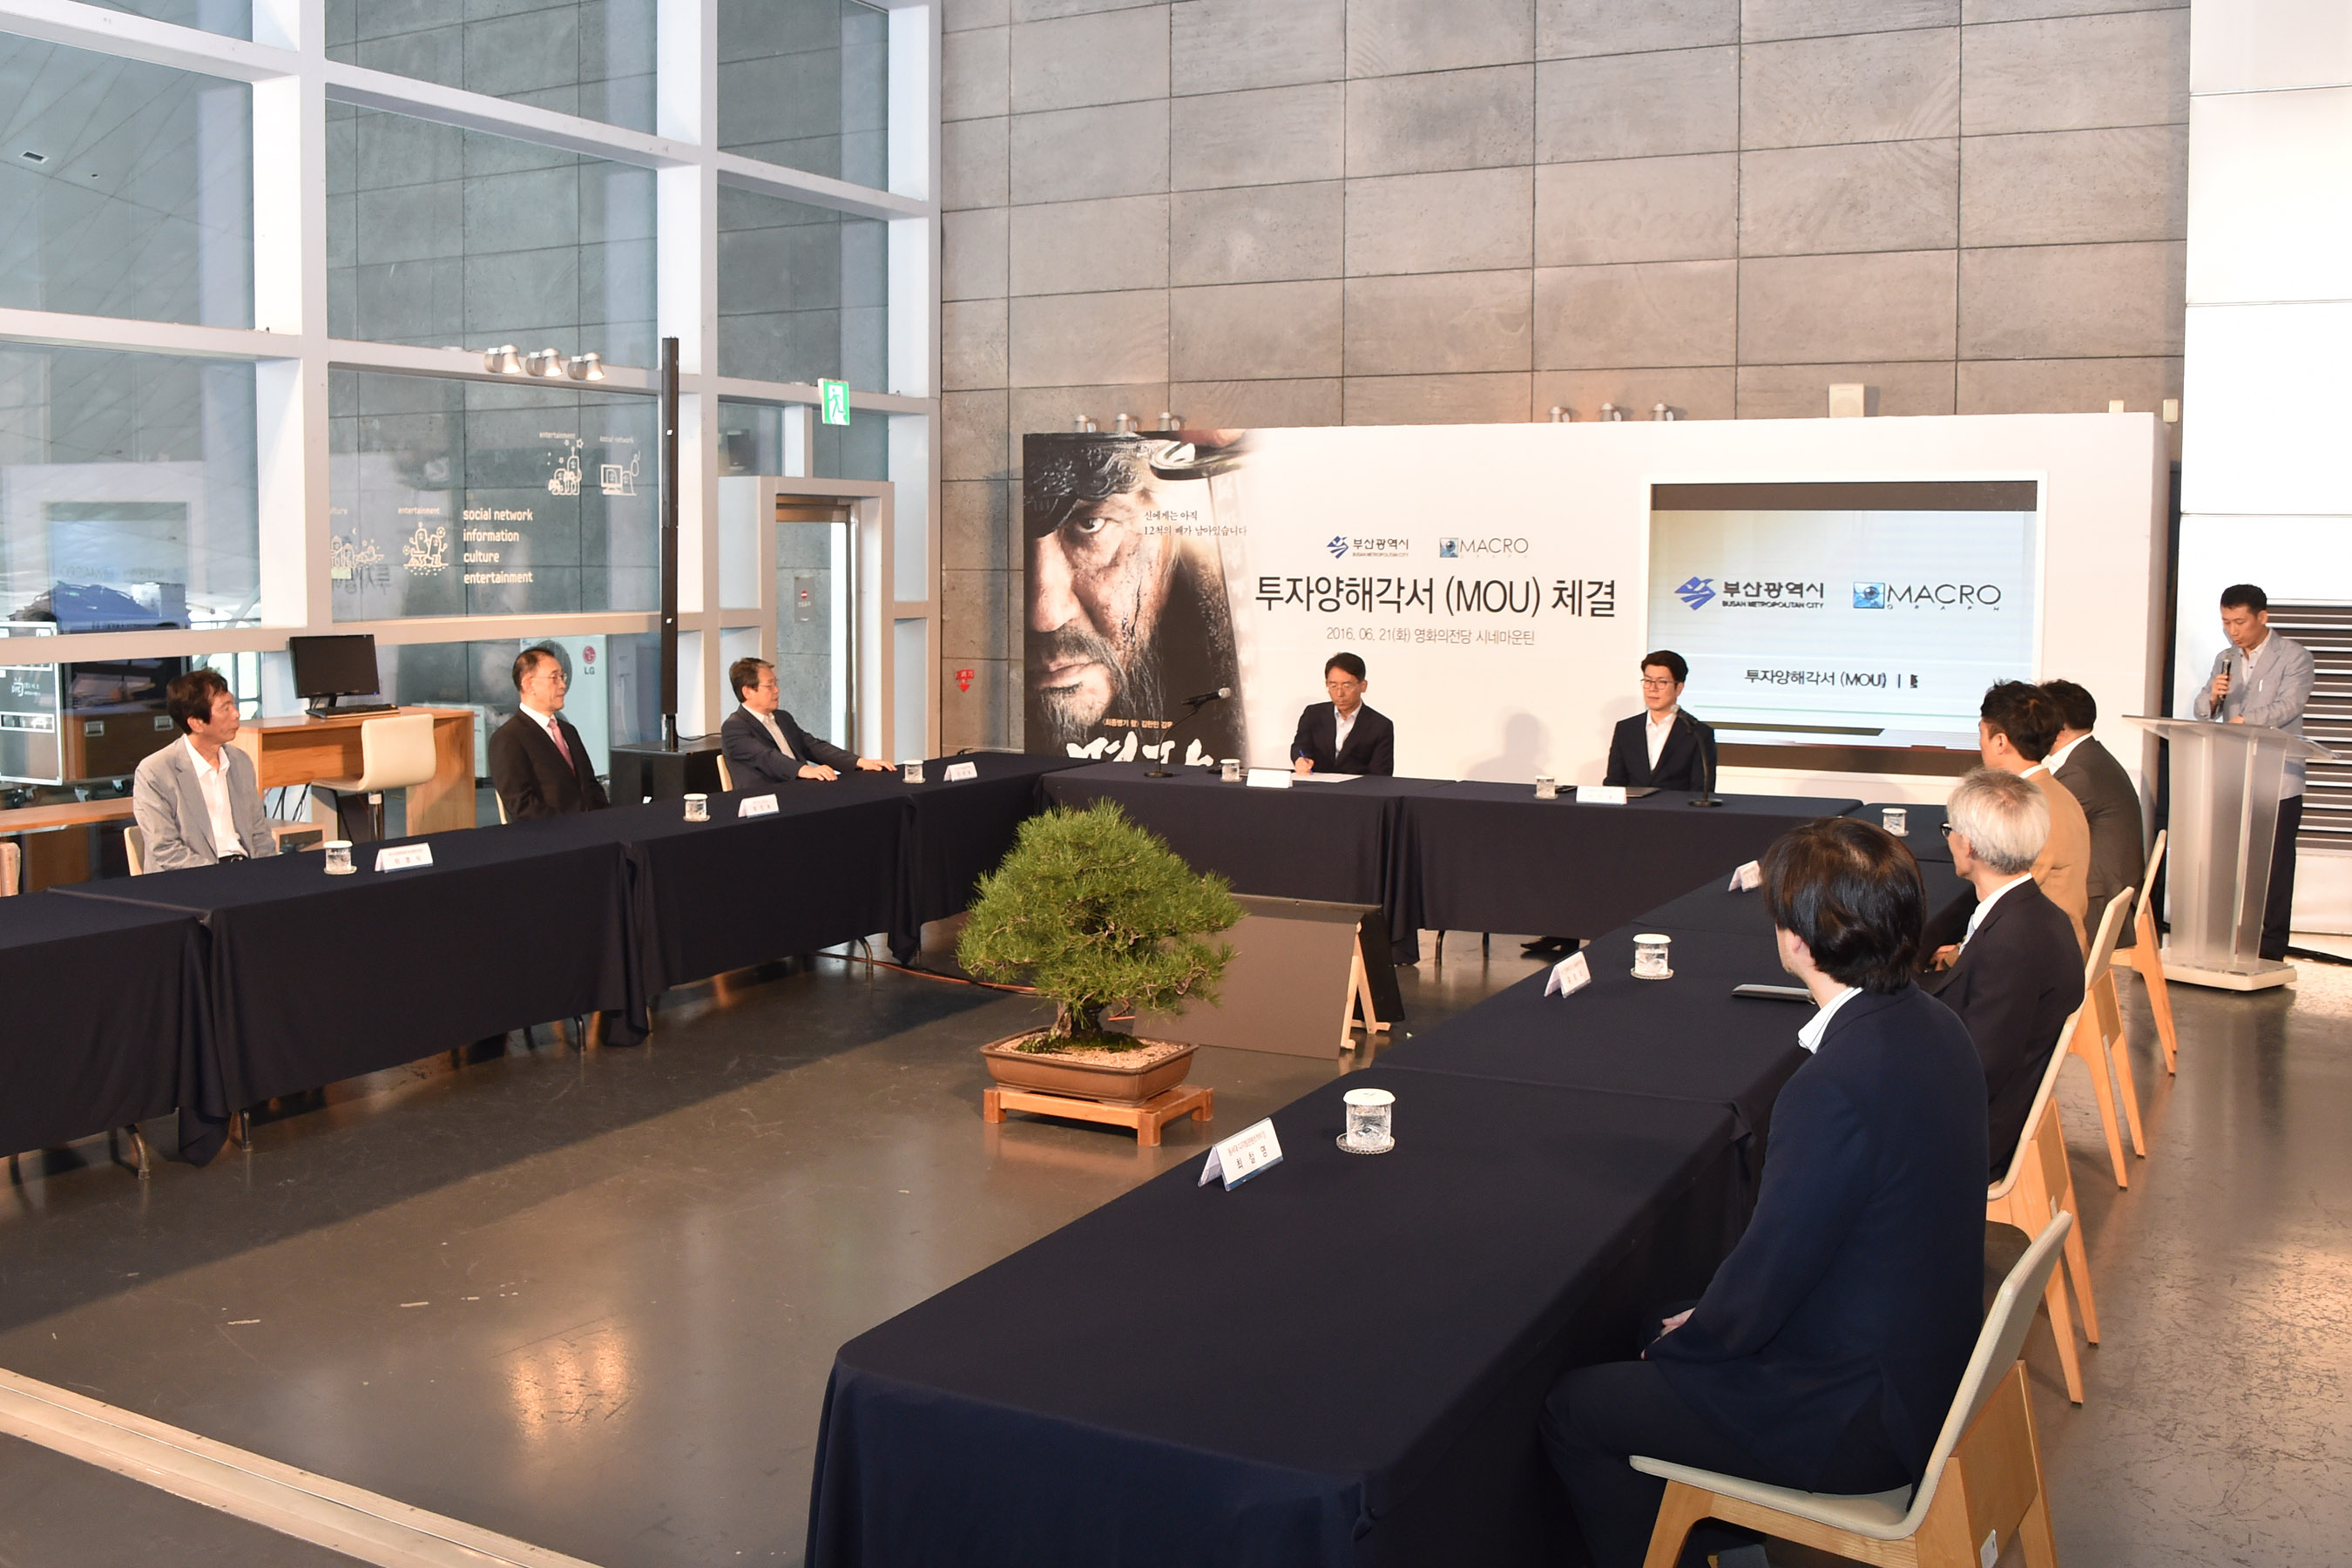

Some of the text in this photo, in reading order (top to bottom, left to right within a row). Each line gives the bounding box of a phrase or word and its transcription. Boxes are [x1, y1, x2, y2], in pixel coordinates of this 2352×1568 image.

[397, 506, 440, 515] entertainment
[463, 508, 534, 521] social network
[1144, 510, 1198, 521] 신에게는 아직
[463, 527, 520, 542] information
[1194, 525, 1247, 536] 남아있습니다
[1353, 538, 1409, 551] 부산광역시
[1459, 537, 1529, 553] MACRO
[463, 551, 500, 564] culture
[463, 571, 534, 585] entertainment
[1255, 575, 1616, 618] 투자양해각서 (MOU) 체결
[1723, 581, 1824, 599] 부산광역시
[1887, 584, 2002, 605] MACRO
[1326, 626, 1536, 645] 2016. 06. 21(화) 영화의전당 시네마운틴
[584, 666, 596, 675] LG
[1744, 669, 1835, 686] 투자양해각서
[1840, 671, 1887, 689] (MOU)
